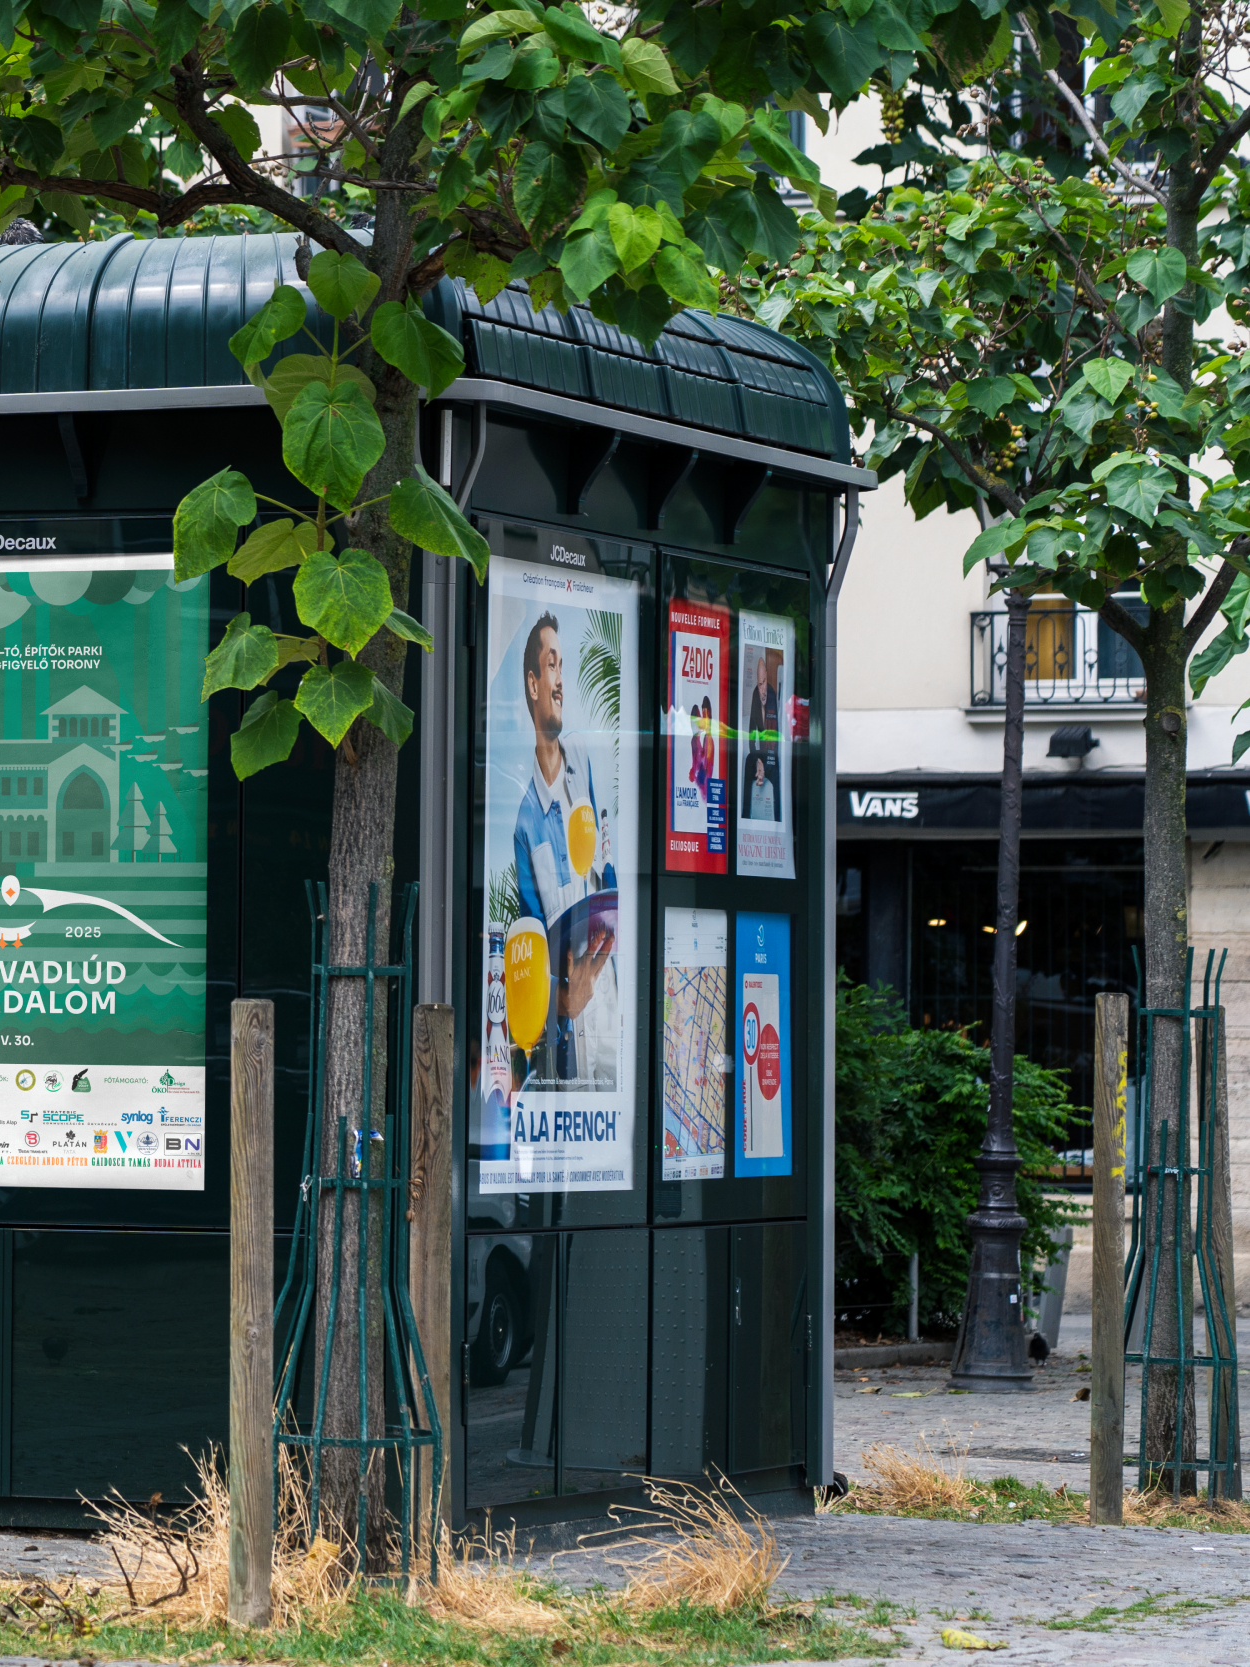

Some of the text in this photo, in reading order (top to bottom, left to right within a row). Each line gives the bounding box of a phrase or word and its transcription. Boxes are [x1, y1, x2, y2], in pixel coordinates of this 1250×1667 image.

[550, 544, 586, 567] JCDecaux
[522, 572, 544, 585] Création
[671, 612, 720, 629] NOUVELLE FORMULE
[24, 644, 65, 656] ÉPÍTŐK
[68, 646, 102, 656] PARKI
[51, 660, 100, 669] TORONY
[682, 646, 713, 680] ZADIG
[676, 787, 697, 800] L'AMOUR
[849, 791, 919, 818] VANS
[65, 926, 101, 938] 2025
[511, 935, 533, 964] 1664
[755, 953, 767, 964] PARIS
[488, 987, 505, 1013] 1664
[14, 1035, 34, 1046] 30.
[747, 1019, 756, 1049] 30
[121, 1110, 153, 1124] synlog
[515, 1102, 616, 1142] À LA FRENCH
[53, 1138, 87, 1148] PLATÁN
[7, 1155, 88, 1166] CZEGLÉDI ANDOR PÉTER
[92, 1157, 150, 1167] GAIDOSCH TAMÁS
[154, 1158, 201, 1168] BUDAI ATTILA
[536, 1171, 546, 1183] POUR
[546, 1171, 551, 1182] LA
[570, 1171, 591, 1182] CONSOMMER
[592, 1170, 601, 1182] AVEC
